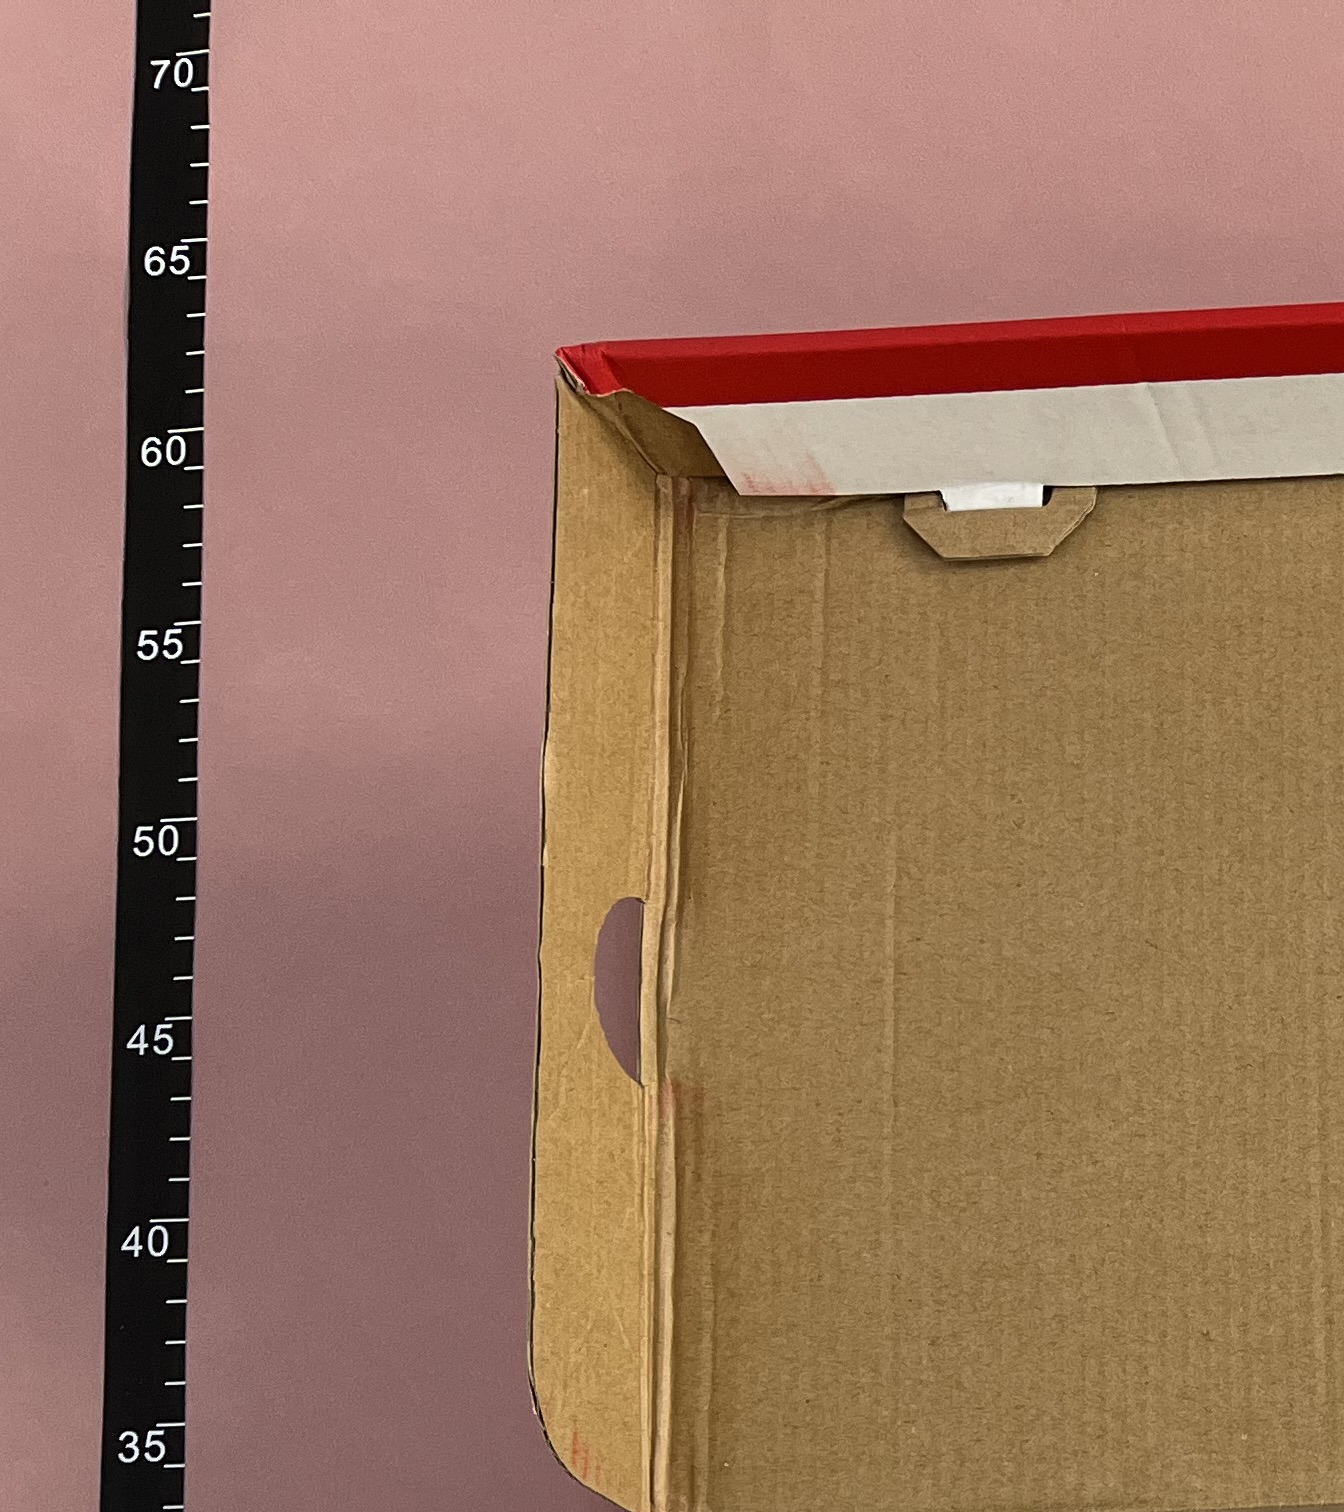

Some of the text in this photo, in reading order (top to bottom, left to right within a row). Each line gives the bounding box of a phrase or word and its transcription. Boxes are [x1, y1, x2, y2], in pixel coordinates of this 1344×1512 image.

[150, 57, 194, 90] 70
[144, 244, 191, 277] 65
[141, 435, 186, 467] 60
[136, 628, 183, 661] 55
[132, 824, 179, 857] 50
[126, 1023, 174, 1056] 45
[120, 1225, 169, 1258] 40
[117, 1430, 166, 1463] 35
